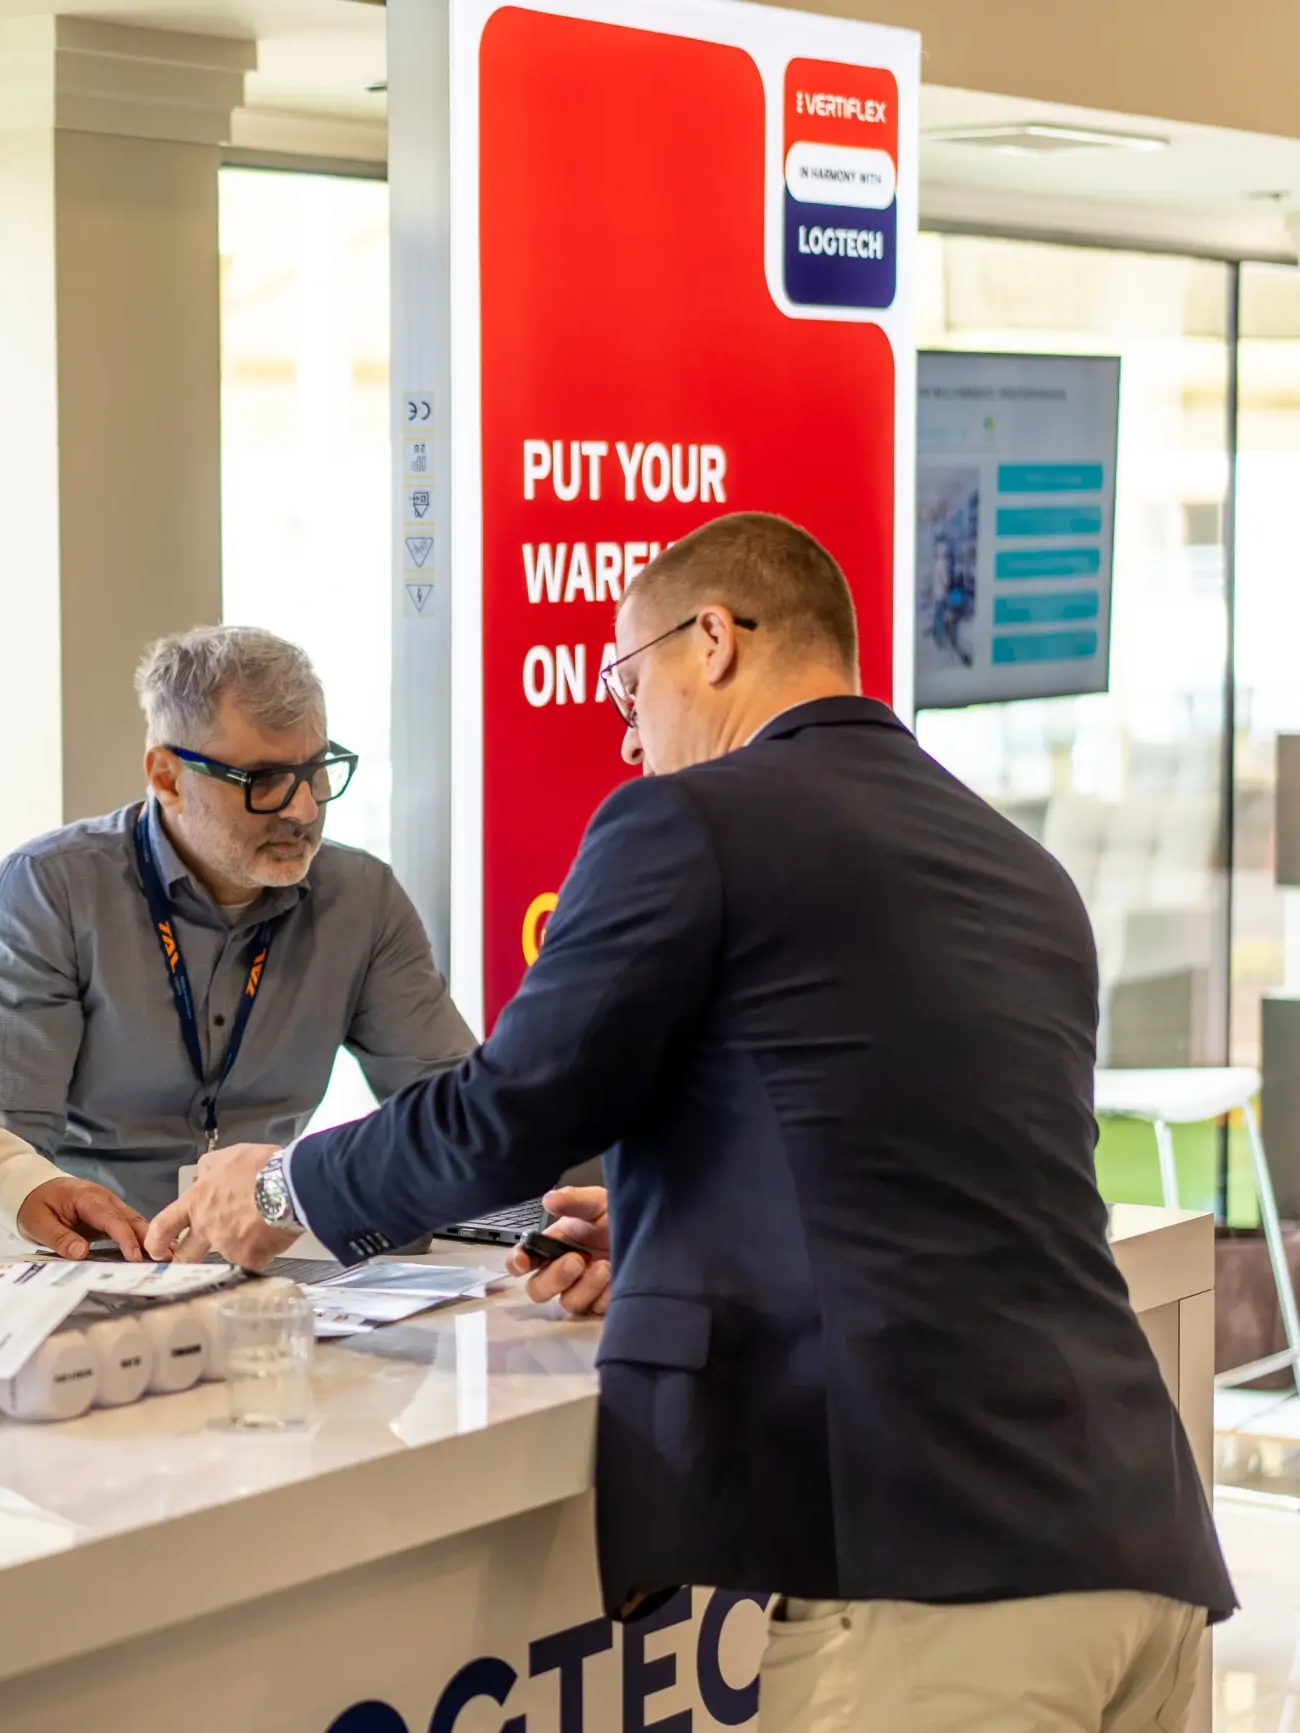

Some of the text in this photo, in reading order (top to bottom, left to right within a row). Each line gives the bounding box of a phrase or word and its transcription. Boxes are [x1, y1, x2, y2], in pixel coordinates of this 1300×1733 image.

[804, 92, 888, 124] VERTIFLEX
[799, 165, 883, 185] IN HARMONY WITH
[798, 224, 884, 260] LOGTECH
[523, 439, 727, 503] PUT YOUR
[522, 642, 587, 708] ON
[158, 921, 180, 974] TAL
[246, 948, 267, 997] TAL
